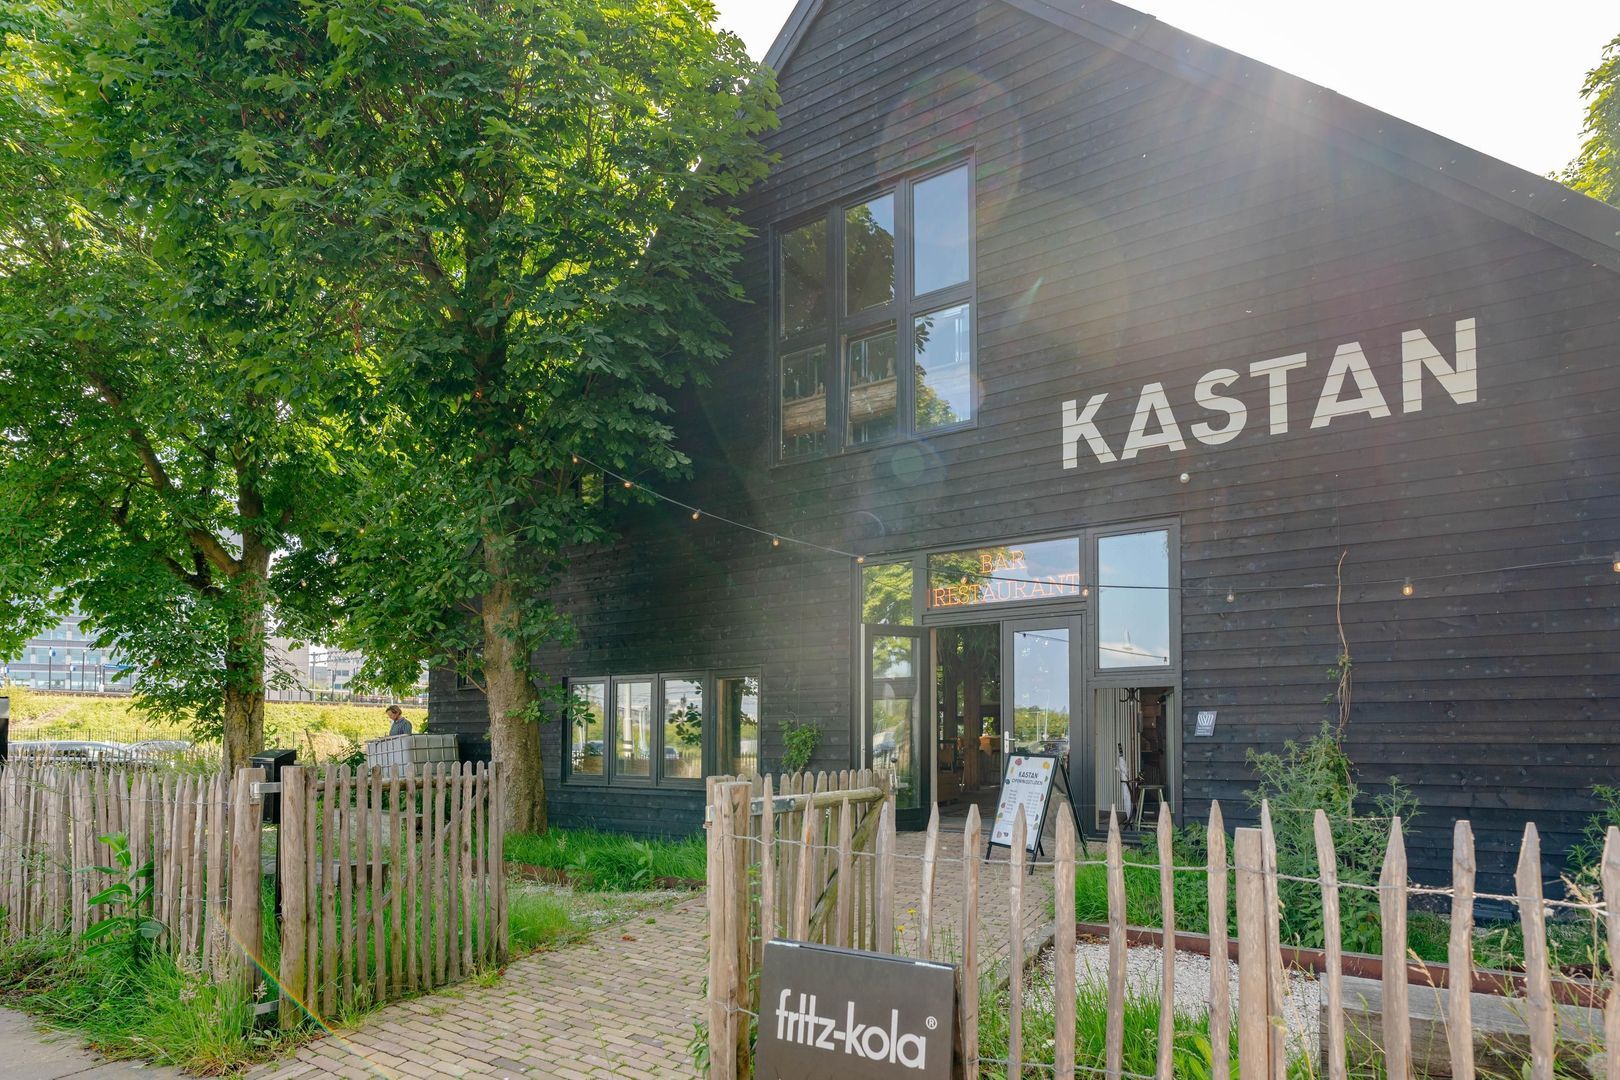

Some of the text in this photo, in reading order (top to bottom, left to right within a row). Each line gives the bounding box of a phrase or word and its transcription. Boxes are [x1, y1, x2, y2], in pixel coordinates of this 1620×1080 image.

[1062, 317, 1478, 469] KASTAN
[980, 550, 1025, 574] BAR
[932, 573, 1079, 607] RESTAURANT
[1018, 771, 1038, 779] KASTAN
